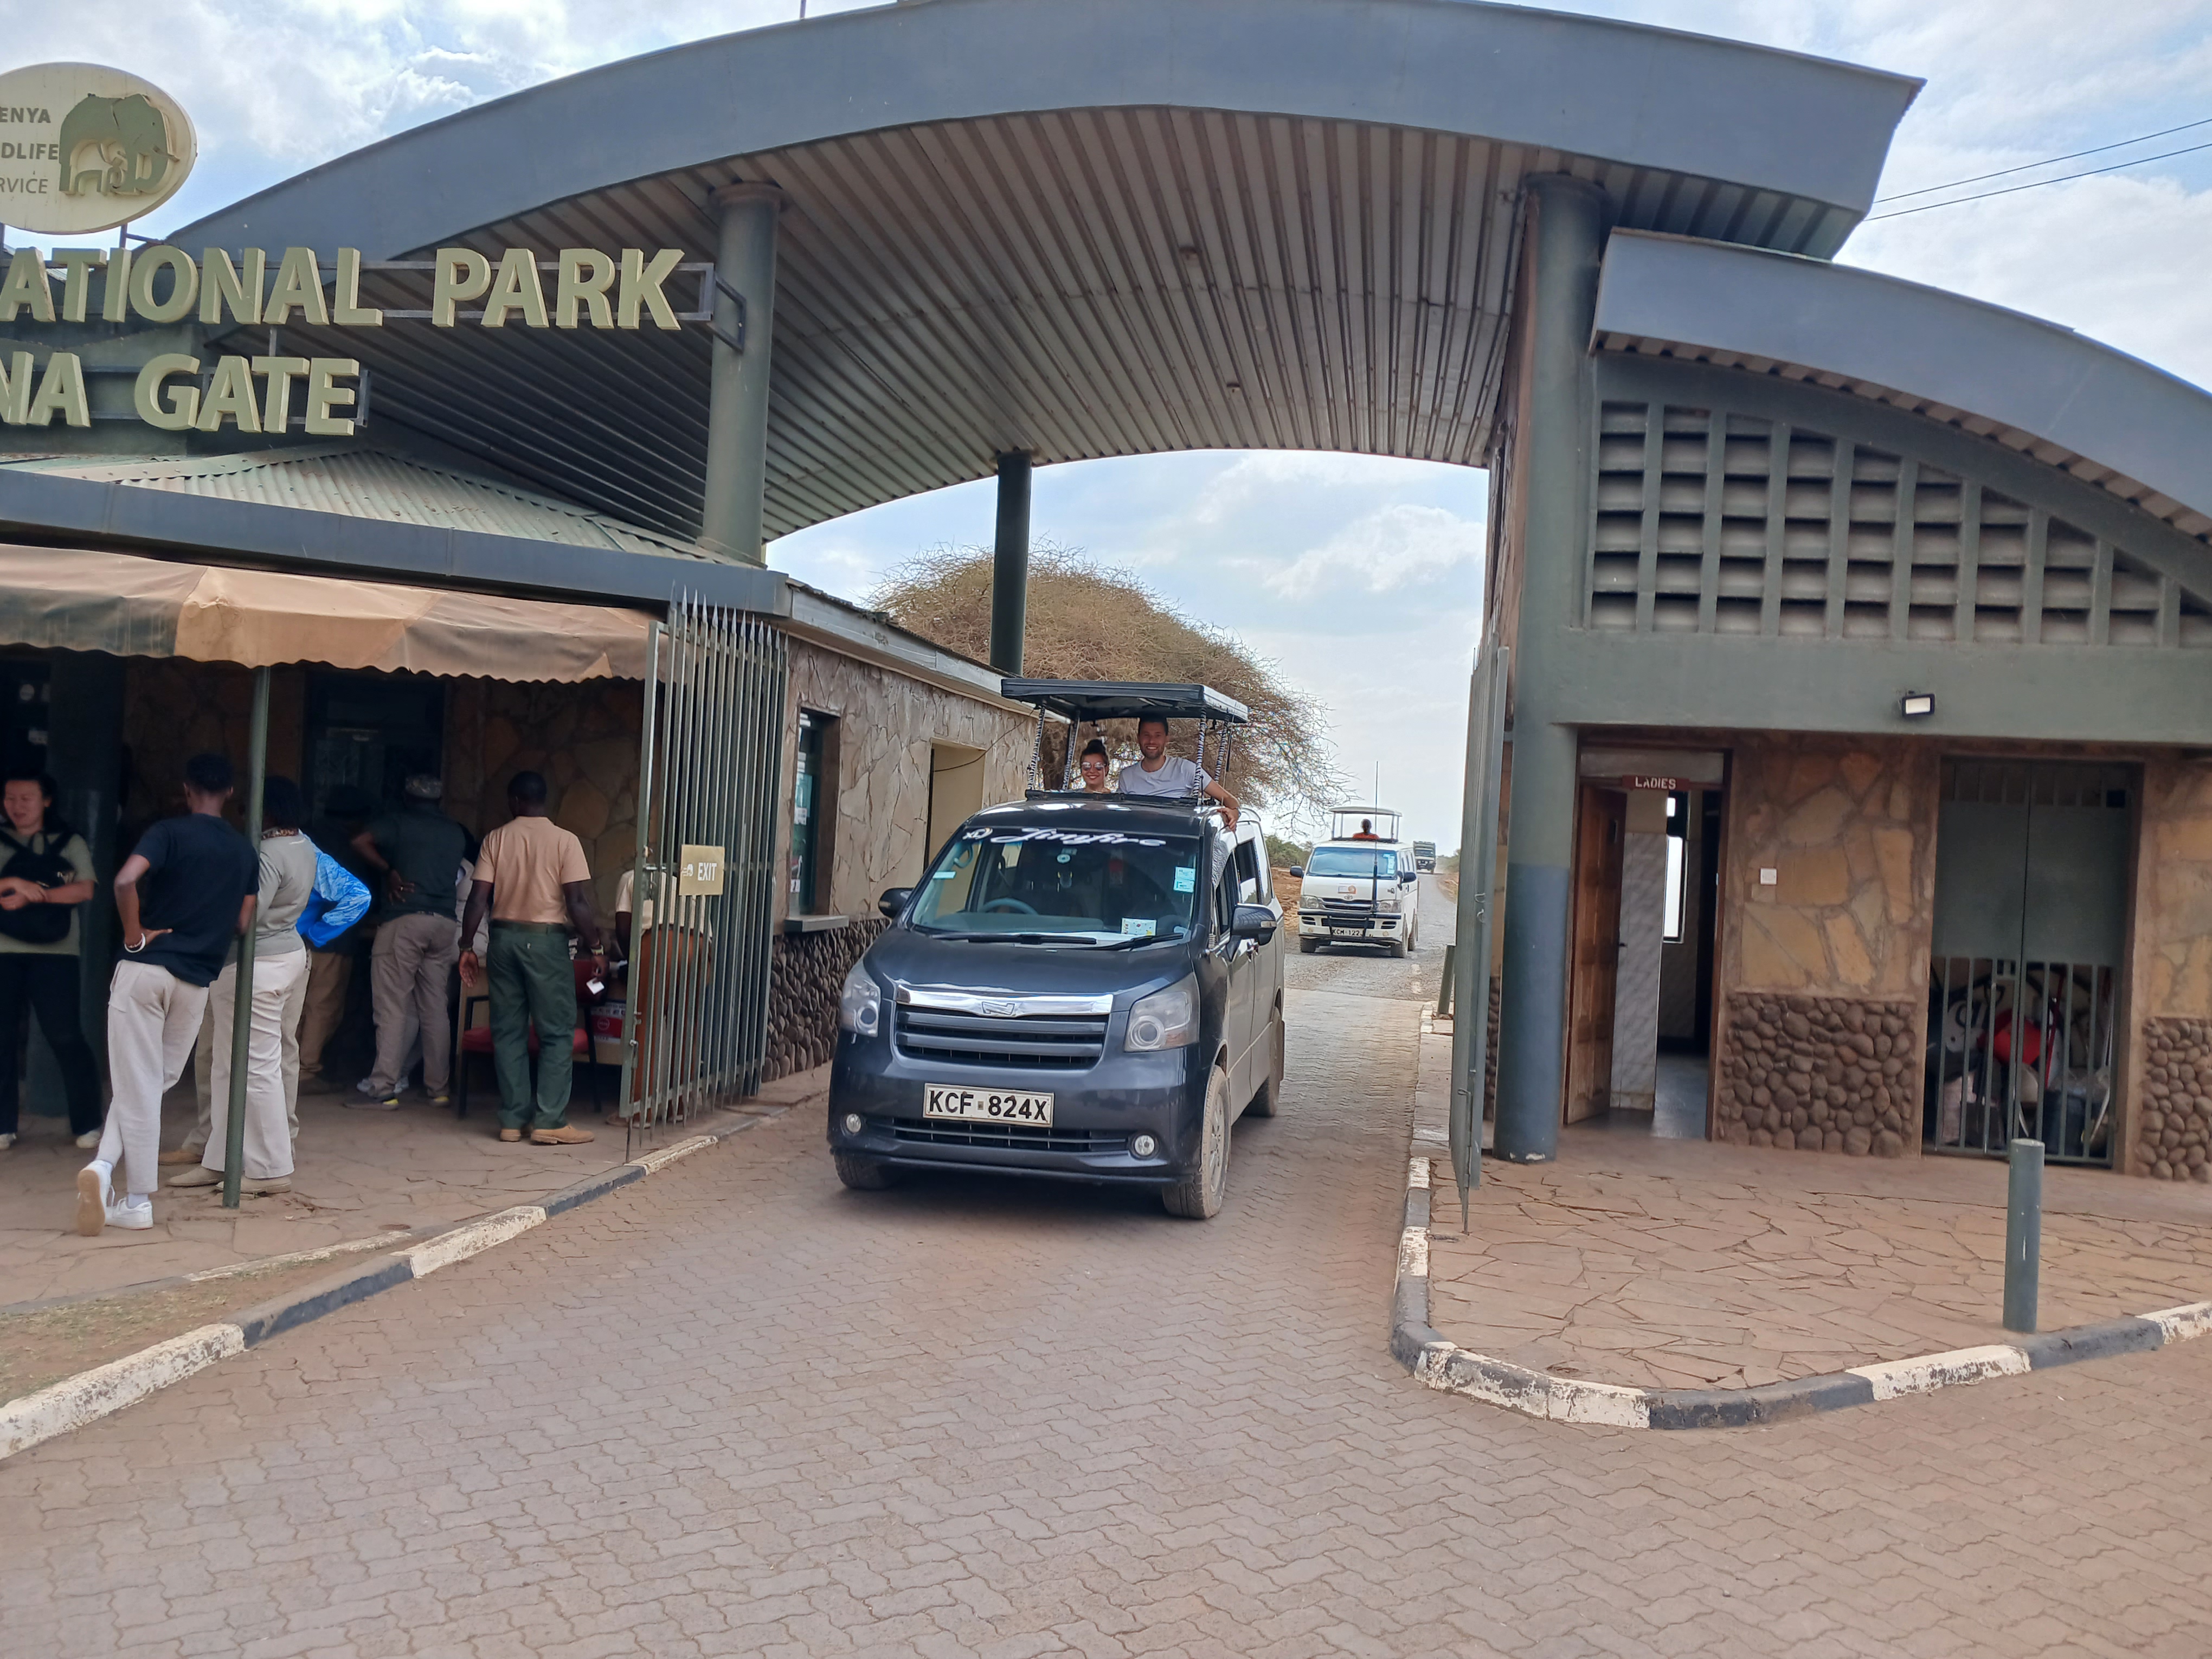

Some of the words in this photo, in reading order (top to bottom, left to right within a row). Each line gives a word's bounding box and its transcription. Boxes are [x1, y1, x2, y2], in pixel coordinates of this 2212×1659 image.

[0, 107, 51, 123] ENYA
[1, 142, 59, 160] DLIFE
[0, 245, 382, 326] ATIONAL
[432, 247, 684, 330] PARK
[134, 353, 359, 436] GATE
[1635, 776, 1676, 790] LADIES
[697, 862, 717, 881] EXIT
[929, 1090, 974, 1114] KCF
[988, 1095, 1047, 1121] 824X
